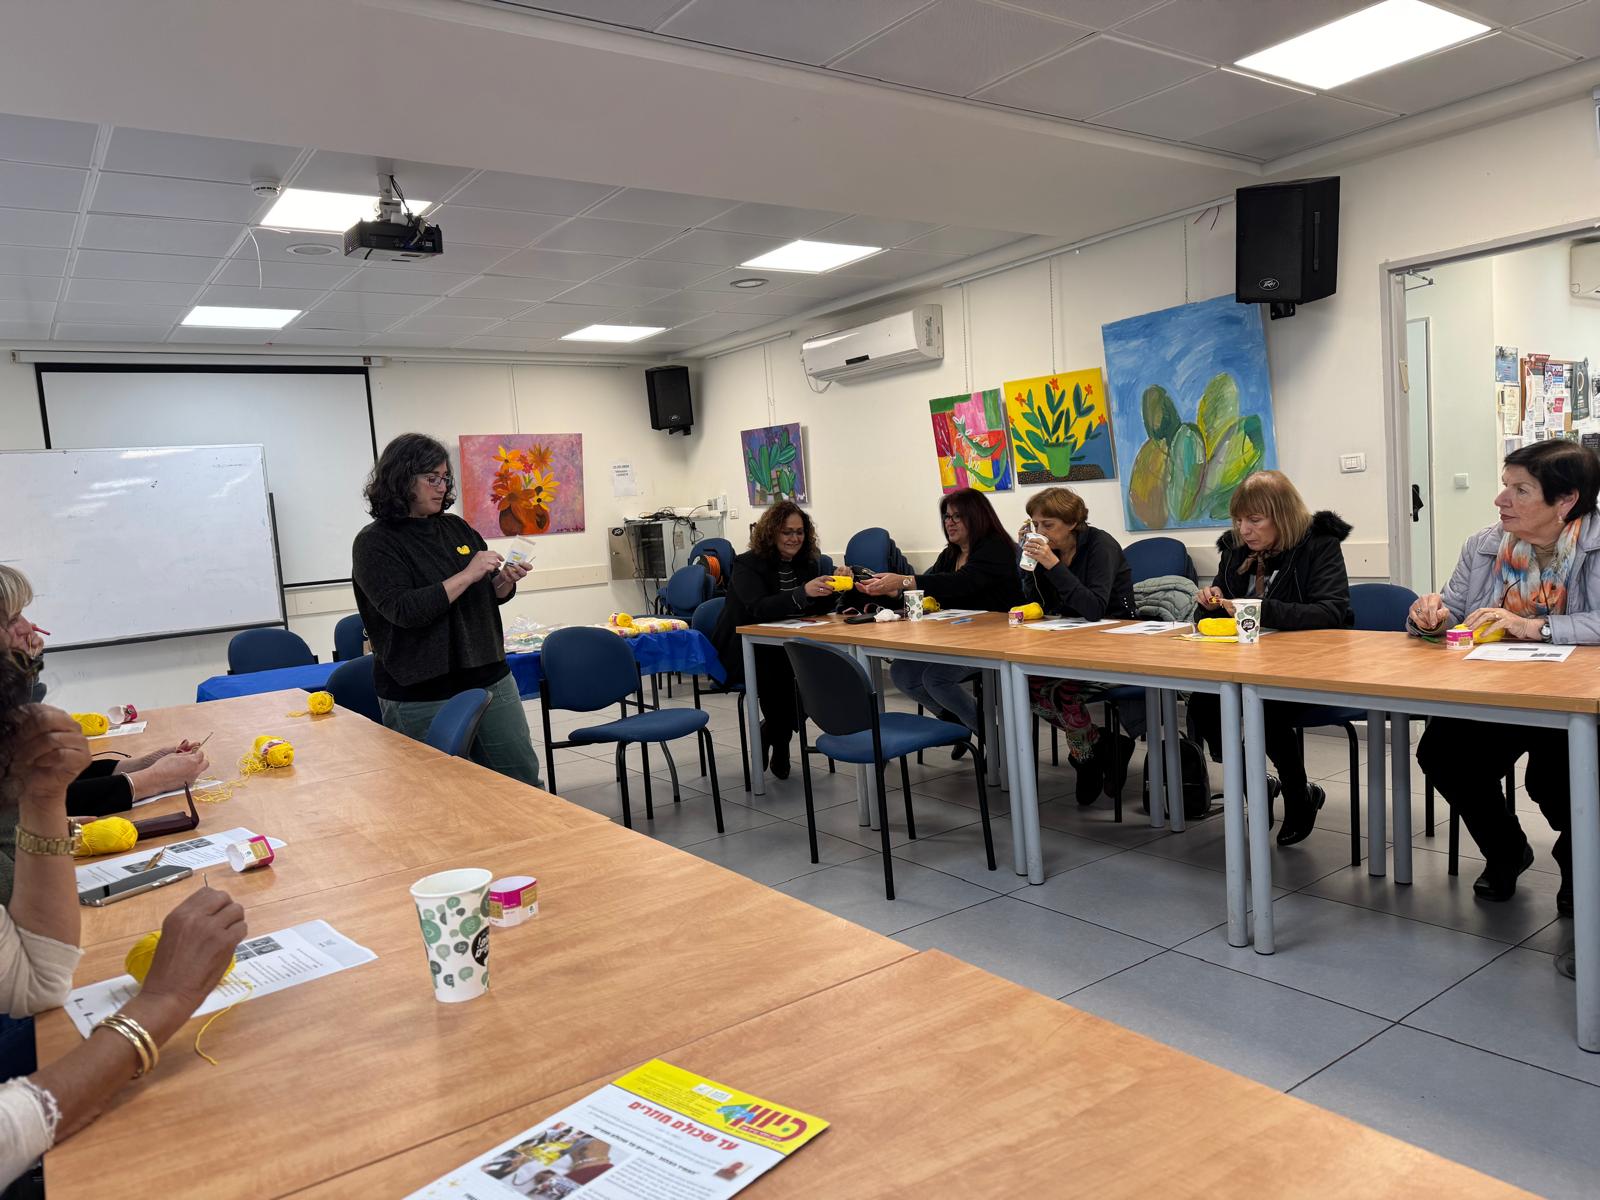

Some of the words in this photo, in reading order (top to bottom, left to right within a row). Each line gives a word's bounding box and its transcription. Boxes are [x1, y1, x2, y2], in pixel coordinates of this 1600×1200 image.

[627, 1101, 673, 1124] חוזרים
[671, 1120, 718, 1143] שכולם
[717, 1138, 740, 1151] עד
